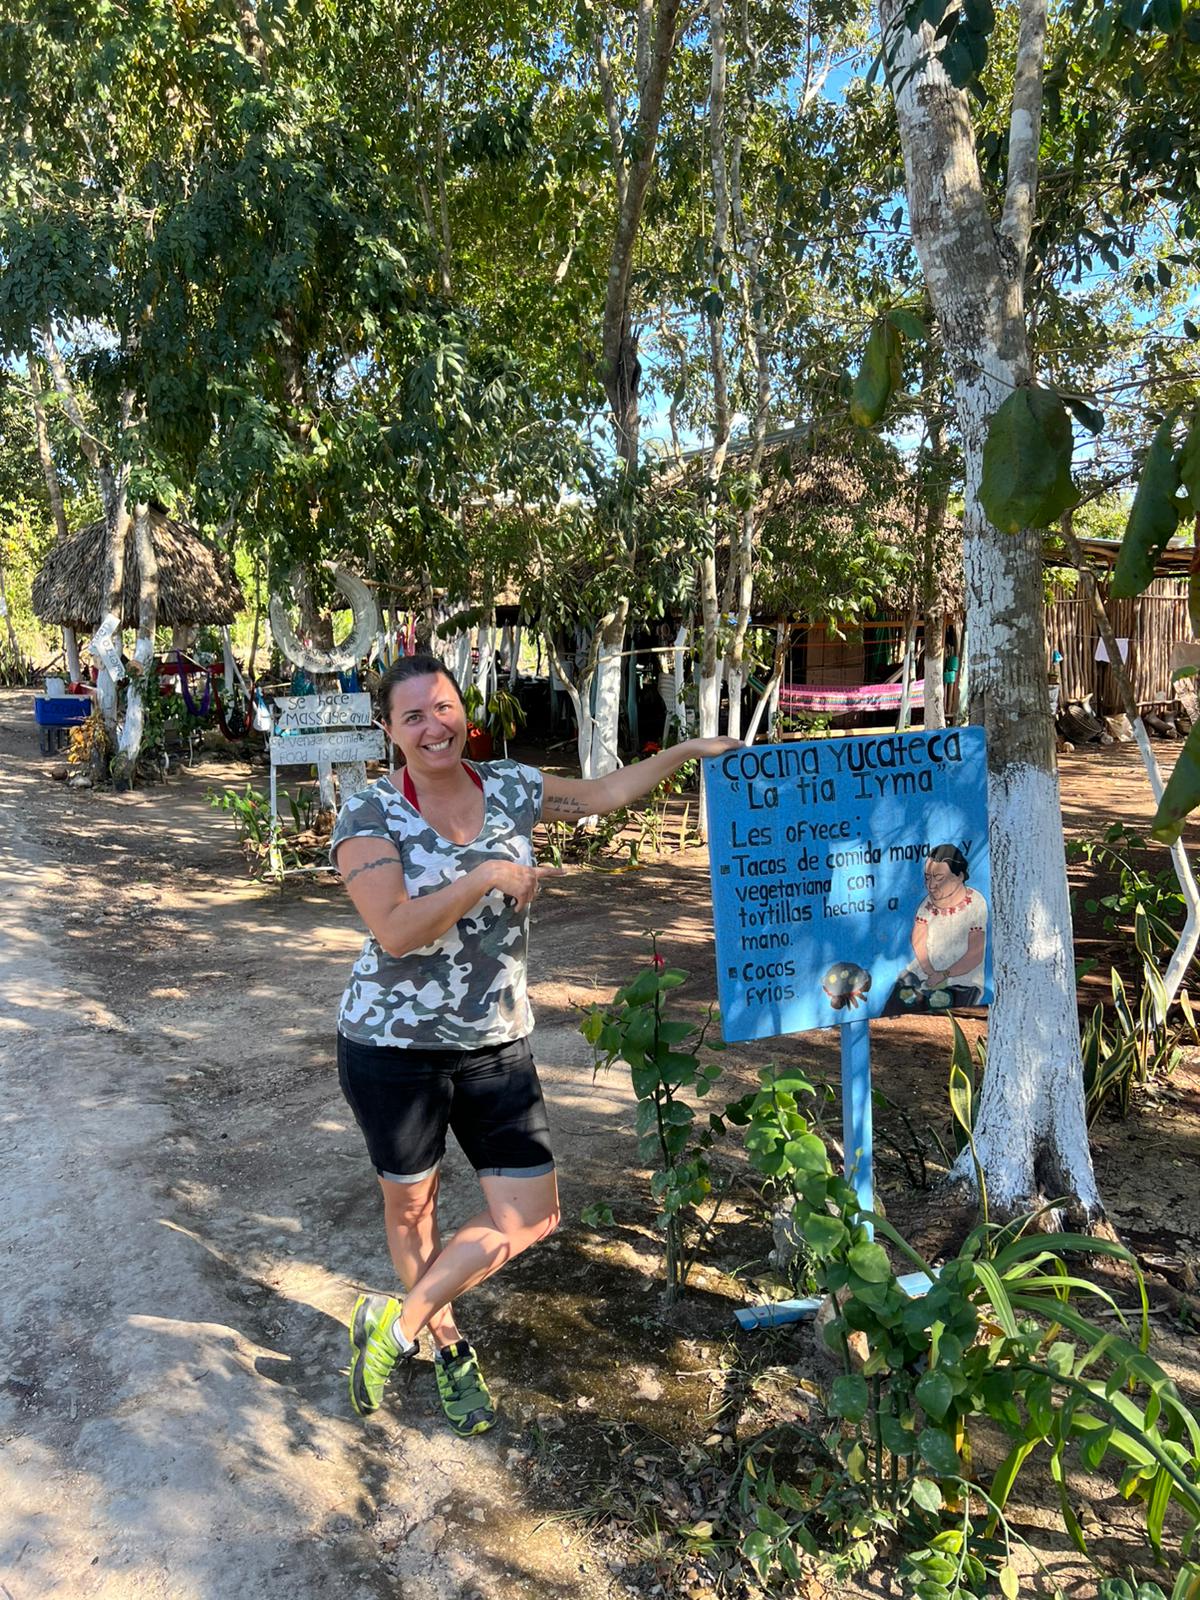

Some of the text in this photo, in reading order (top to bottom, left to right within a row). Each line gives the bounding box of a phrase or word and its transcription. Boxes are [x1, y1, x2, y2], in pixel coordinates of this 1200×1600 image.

[318, 694, 349, 706] hace
[732, 821, 772, 847] Les
[732, 840, 972, 877] Tacos de comida maya y
[735, 874, 875, 907] vegetariana con
[739, 896, 899, 928] tortillas hechas a
[742, 932, 794, 951] mano.
[742, 960, 795, 982] Cocos
